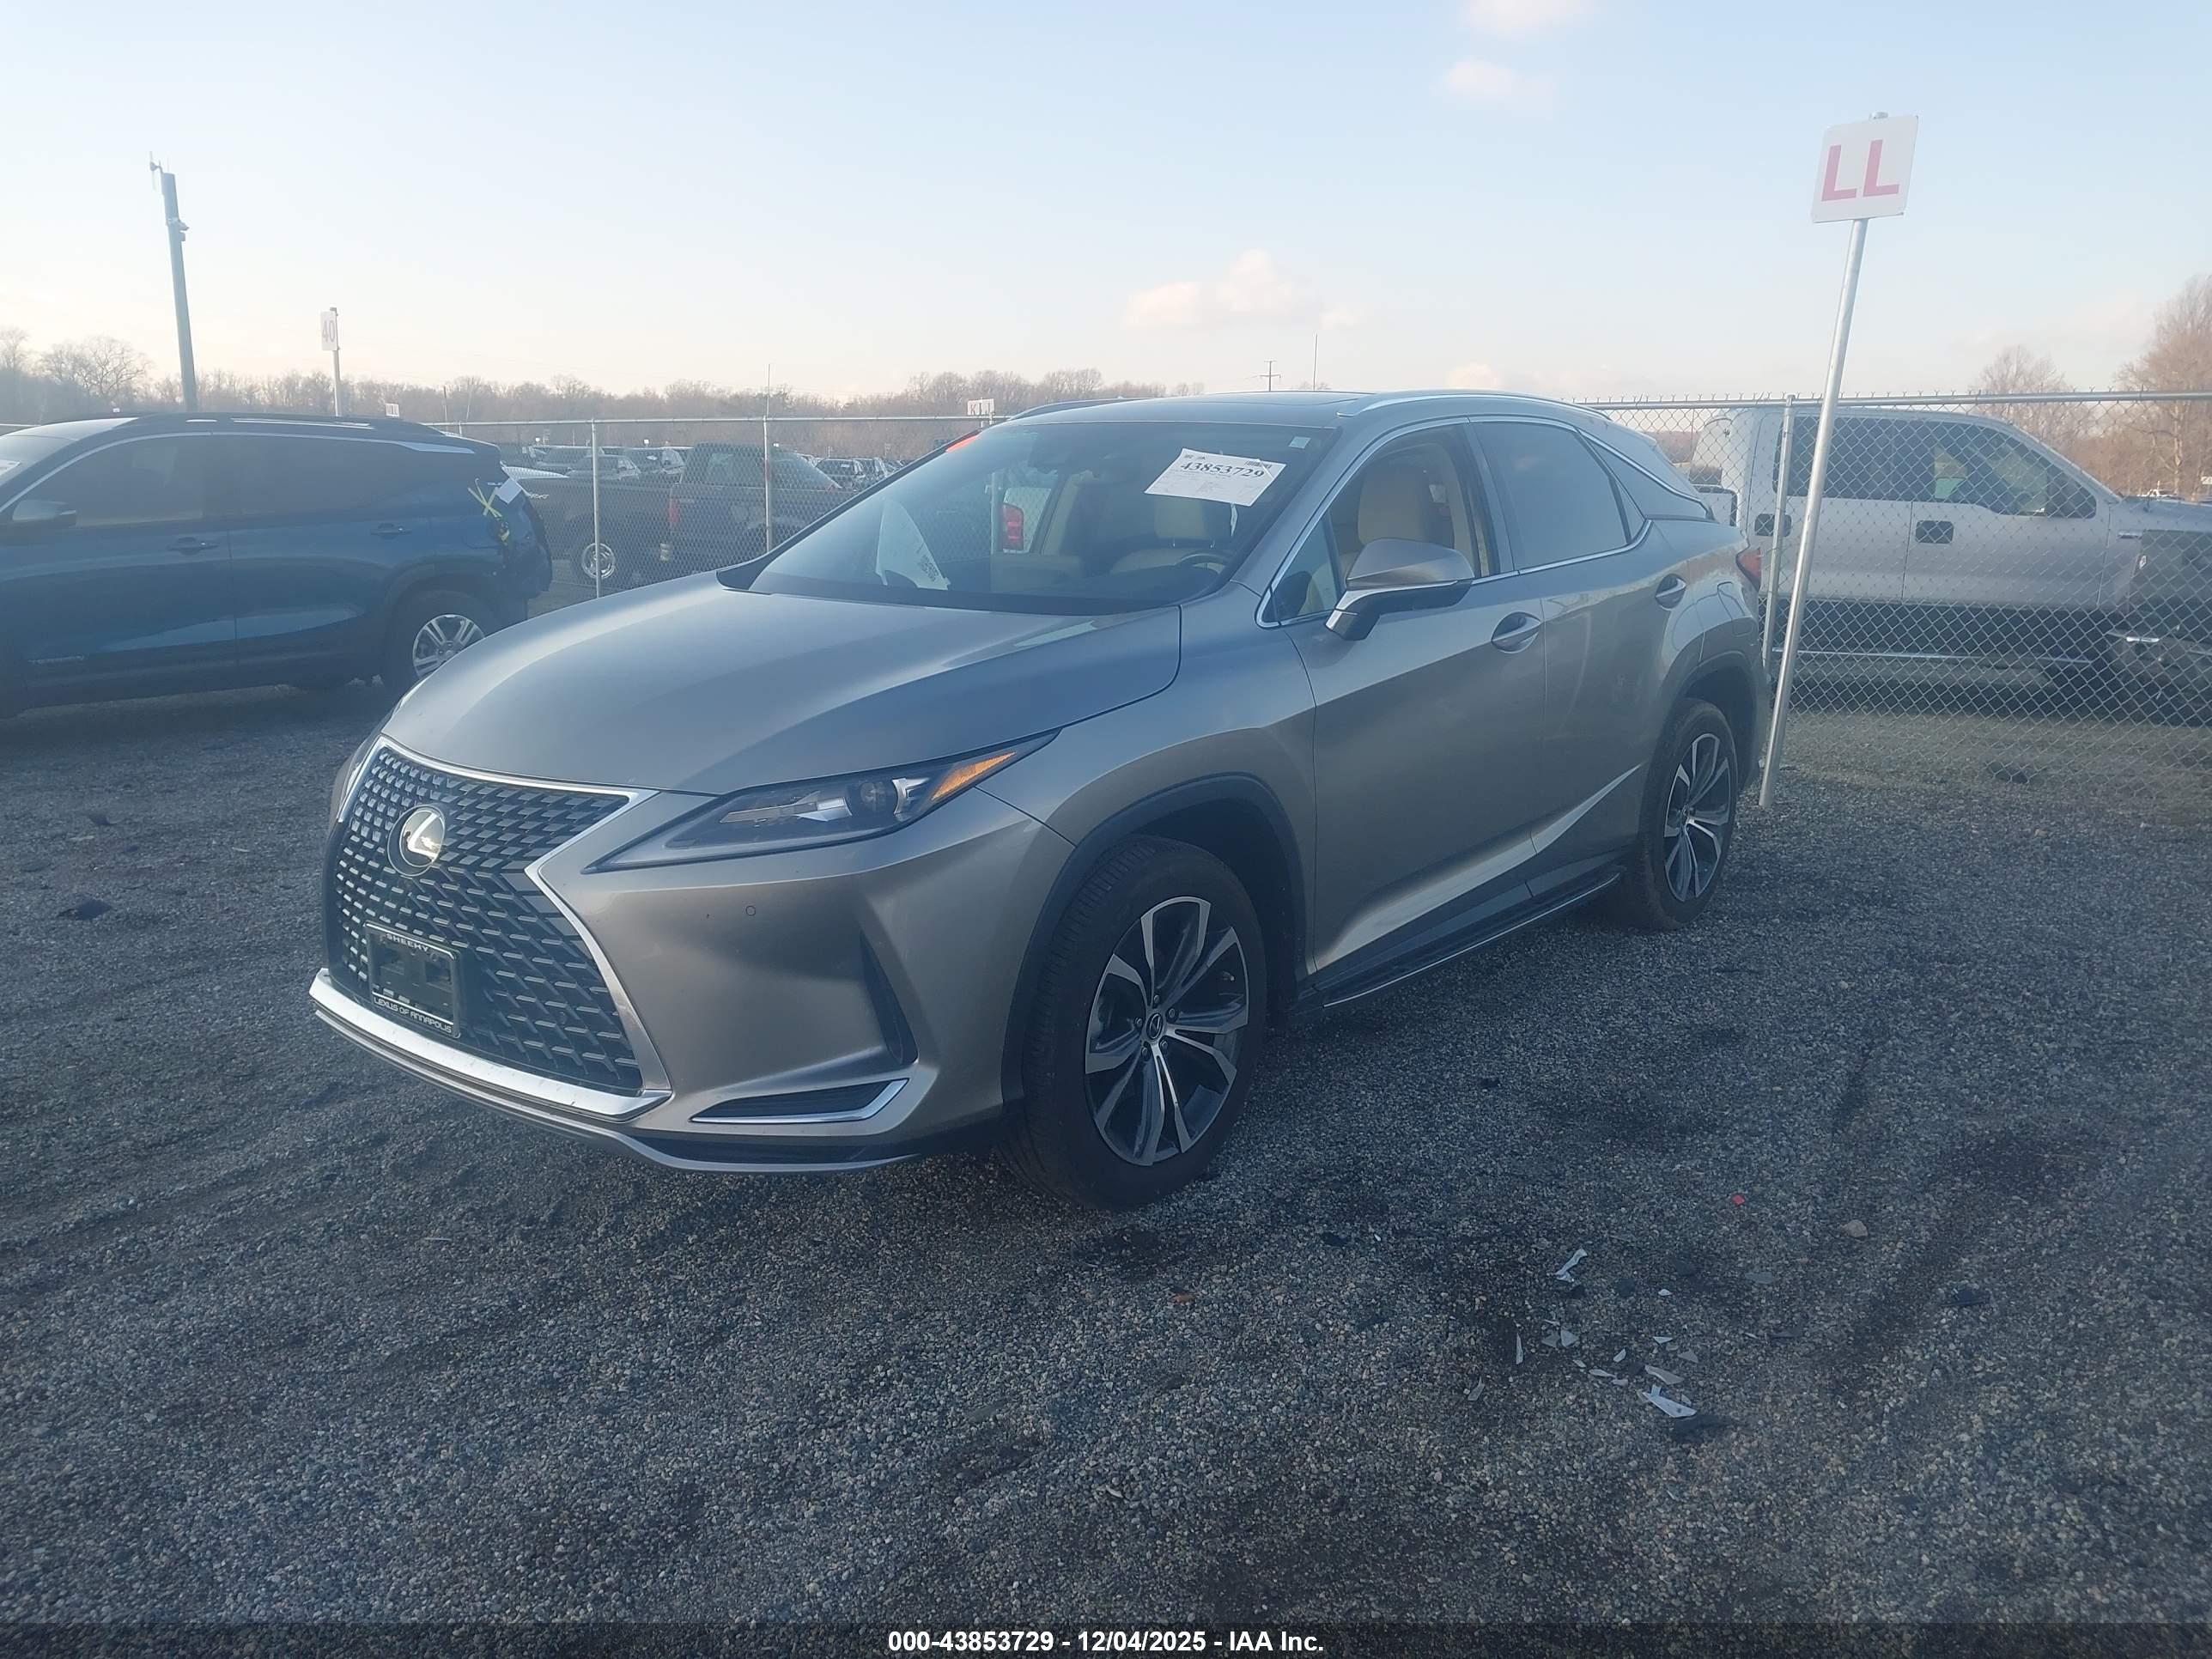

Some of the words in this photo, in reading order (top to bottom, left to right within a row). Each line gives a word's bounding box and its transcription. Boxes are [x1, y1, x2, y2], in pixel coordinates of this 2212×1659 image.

[1821, 139, 1899, 202] LL
[1180, 460, 1265, 478] 43853729
[386, 933, 429, 952] SHEEHY
[374, 996, 399, 1012] LEXUS
[399, 1006, 410, 1016] OF
[410, 1011, 453, 1034] ANNAPOLIS
